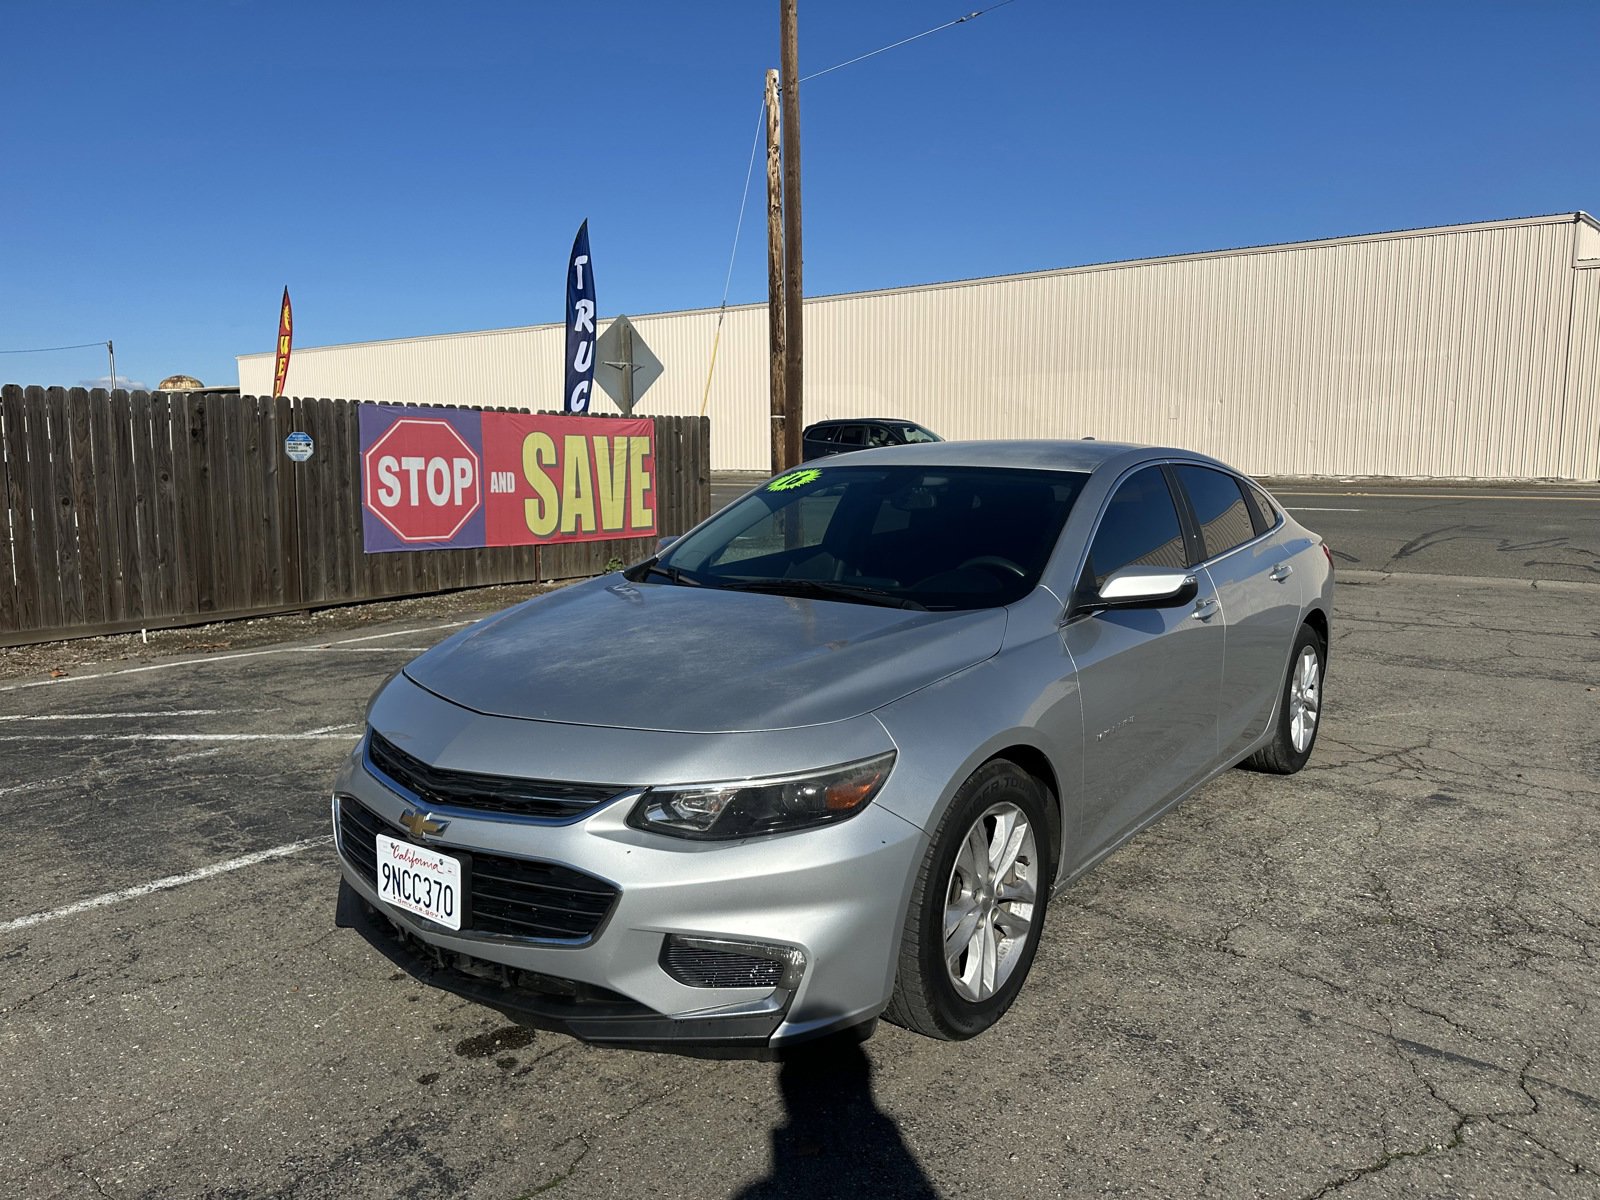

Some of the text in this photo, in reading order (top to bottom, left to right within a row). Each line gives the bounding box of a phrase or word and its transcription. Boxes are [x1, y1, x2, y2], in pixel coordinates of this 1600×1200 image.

[570, 254, 595, 413] TRUC
[377, 431, 653, 537] STOP AND SAVE
[382, 862, 454, 917] 9NCC370
[392, 844, 444, 875] California
